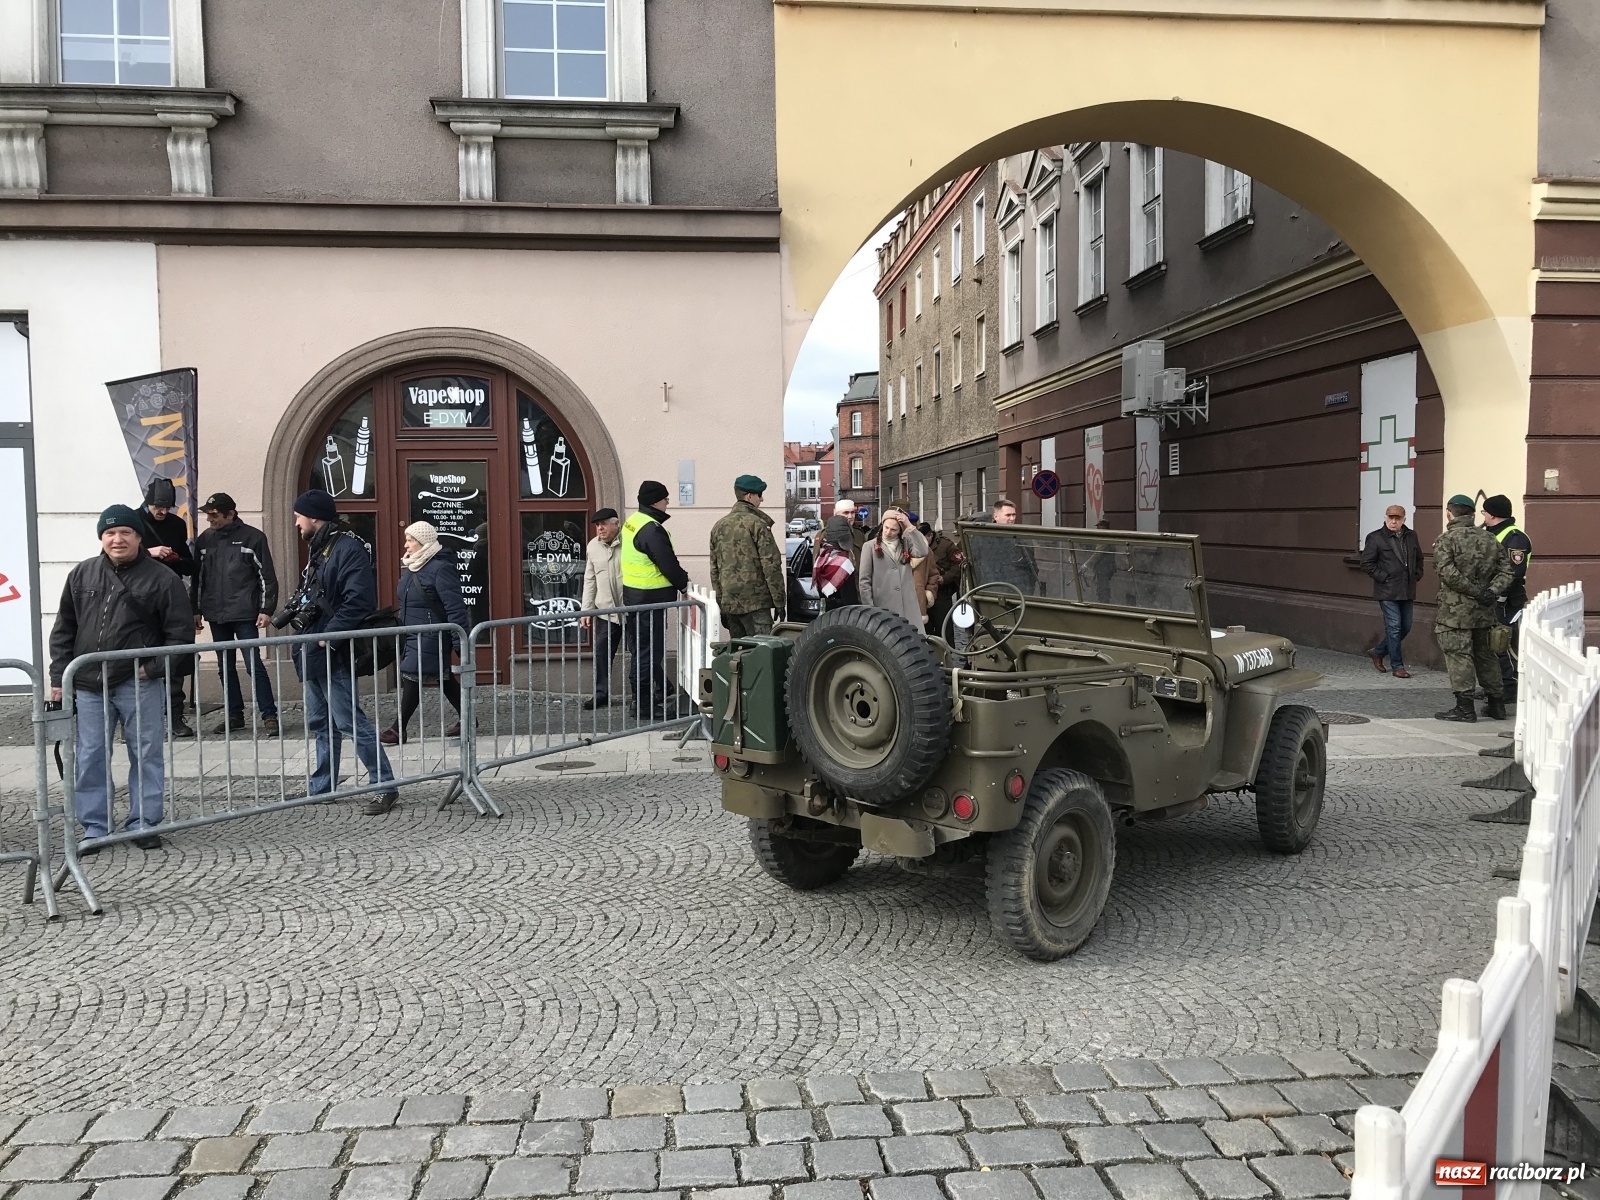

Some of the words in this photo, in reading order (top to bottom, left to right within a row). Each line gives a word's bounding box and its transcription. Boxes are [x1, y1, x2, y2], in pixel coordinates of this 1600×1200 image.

[408, 386, 485, 407] VapeShop
[423, 412, 473, 425] E-DYM
[429, 474, 467, 485] VapeShop
[456, 551, 477, 559] ROSY
[536, 553, 572, 563] E-DYM
[460, 585, 483, 594] TORY
[463, 597, 476, 605] RKI
